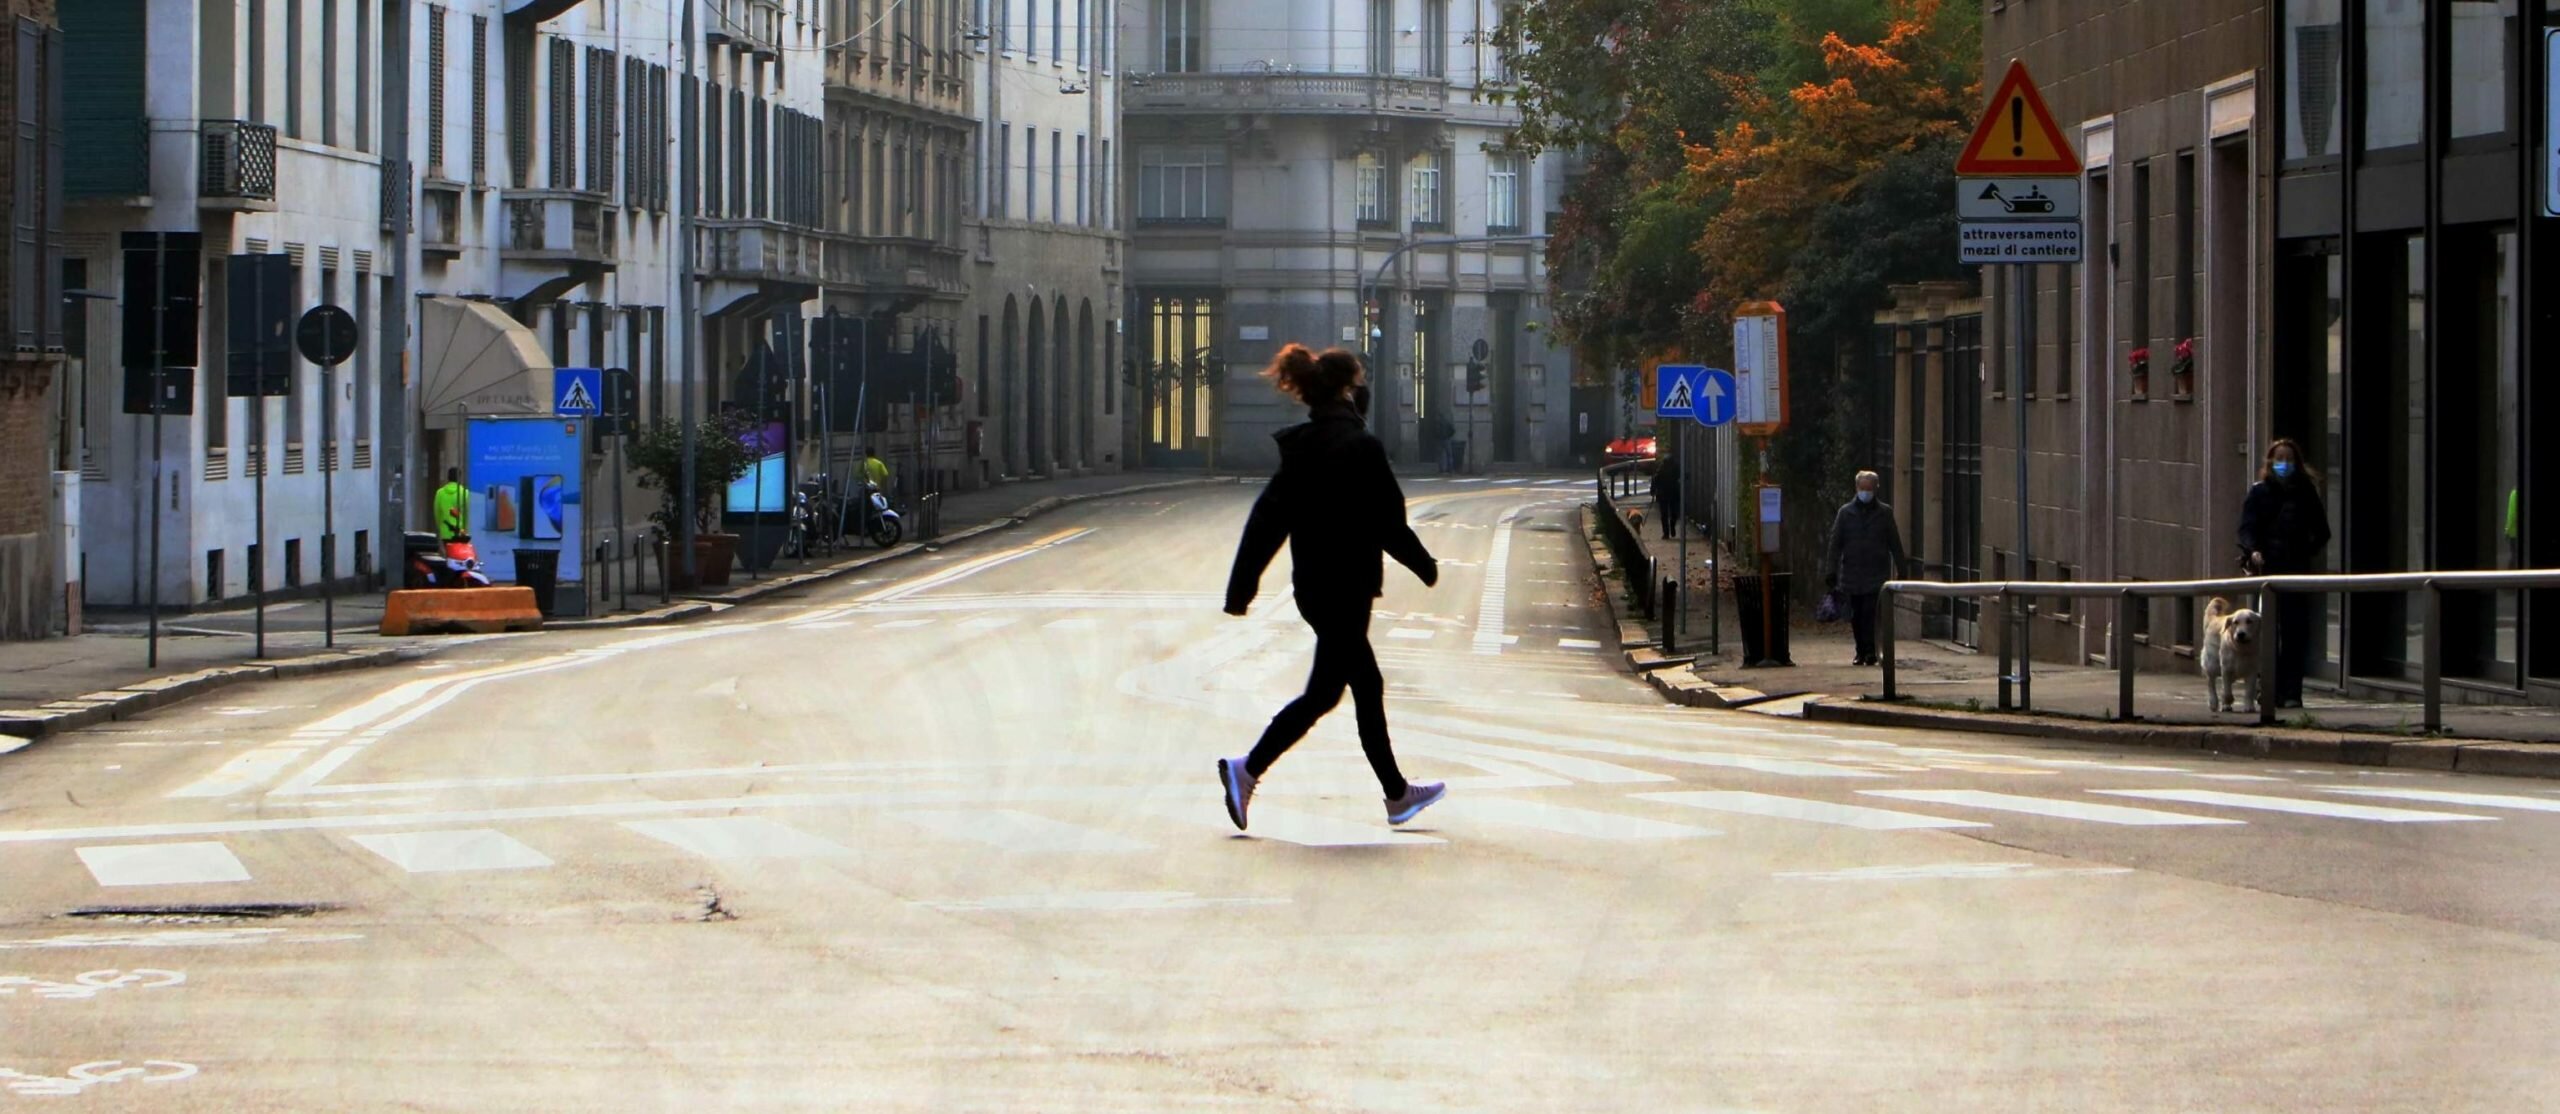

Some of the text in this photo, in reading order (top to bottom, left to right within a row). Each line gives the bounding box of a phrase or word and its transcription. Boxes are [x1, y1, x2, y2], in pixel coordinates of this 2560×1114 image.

[1963, 229, 2077, 240] attraversamento
[1963, 244, 2077, 255] mezzi di cantiere
